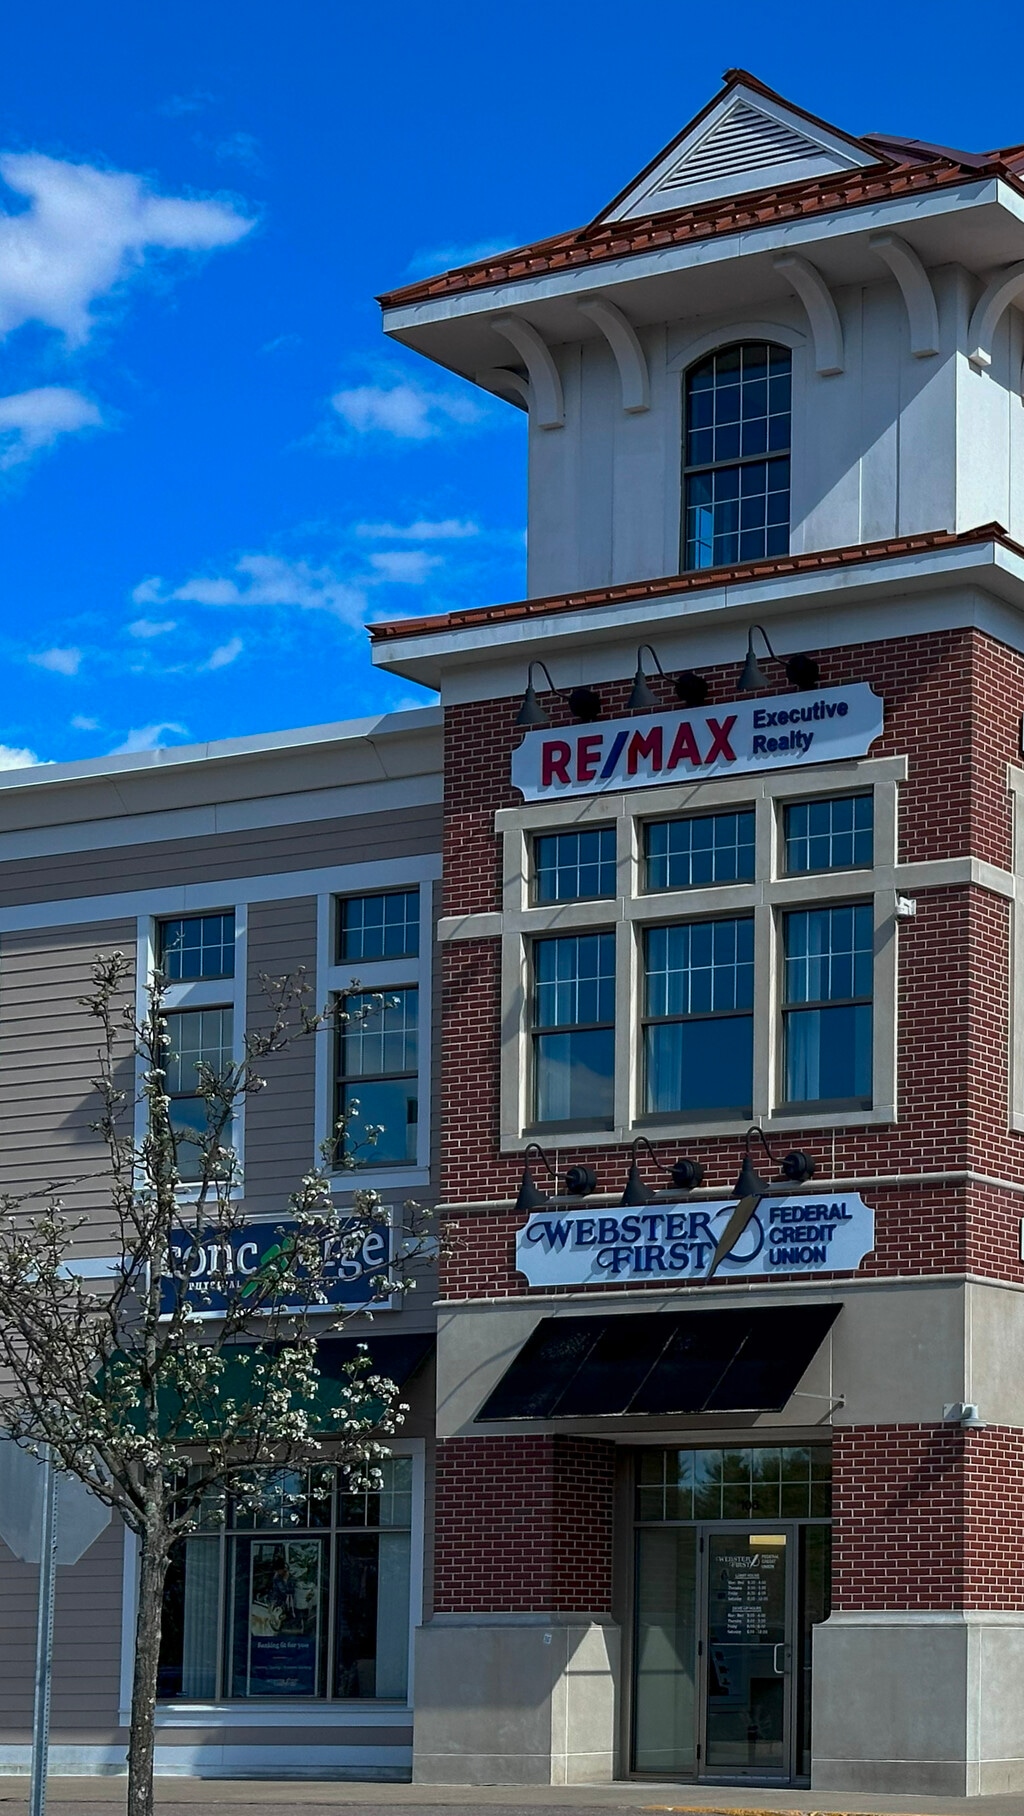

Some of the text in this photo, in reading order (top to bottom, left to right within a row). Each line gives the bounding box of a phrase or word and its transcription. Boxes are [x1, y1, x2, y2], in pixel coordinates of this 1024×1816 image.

[752, 700, 849, 729] Executive
[542, 715, 738, 787] RE/MAX
[752, 730, 814, 754] Realty
[769, 1203, 852, 1223] FEDERAL
[526, 1211, 716, 1249] WEBSTER
[769, 1224, 837, 1244] CREDIT
[597, 1241, 713, 1273] FIRST
[769, 1245, 827, 1265] UNION
